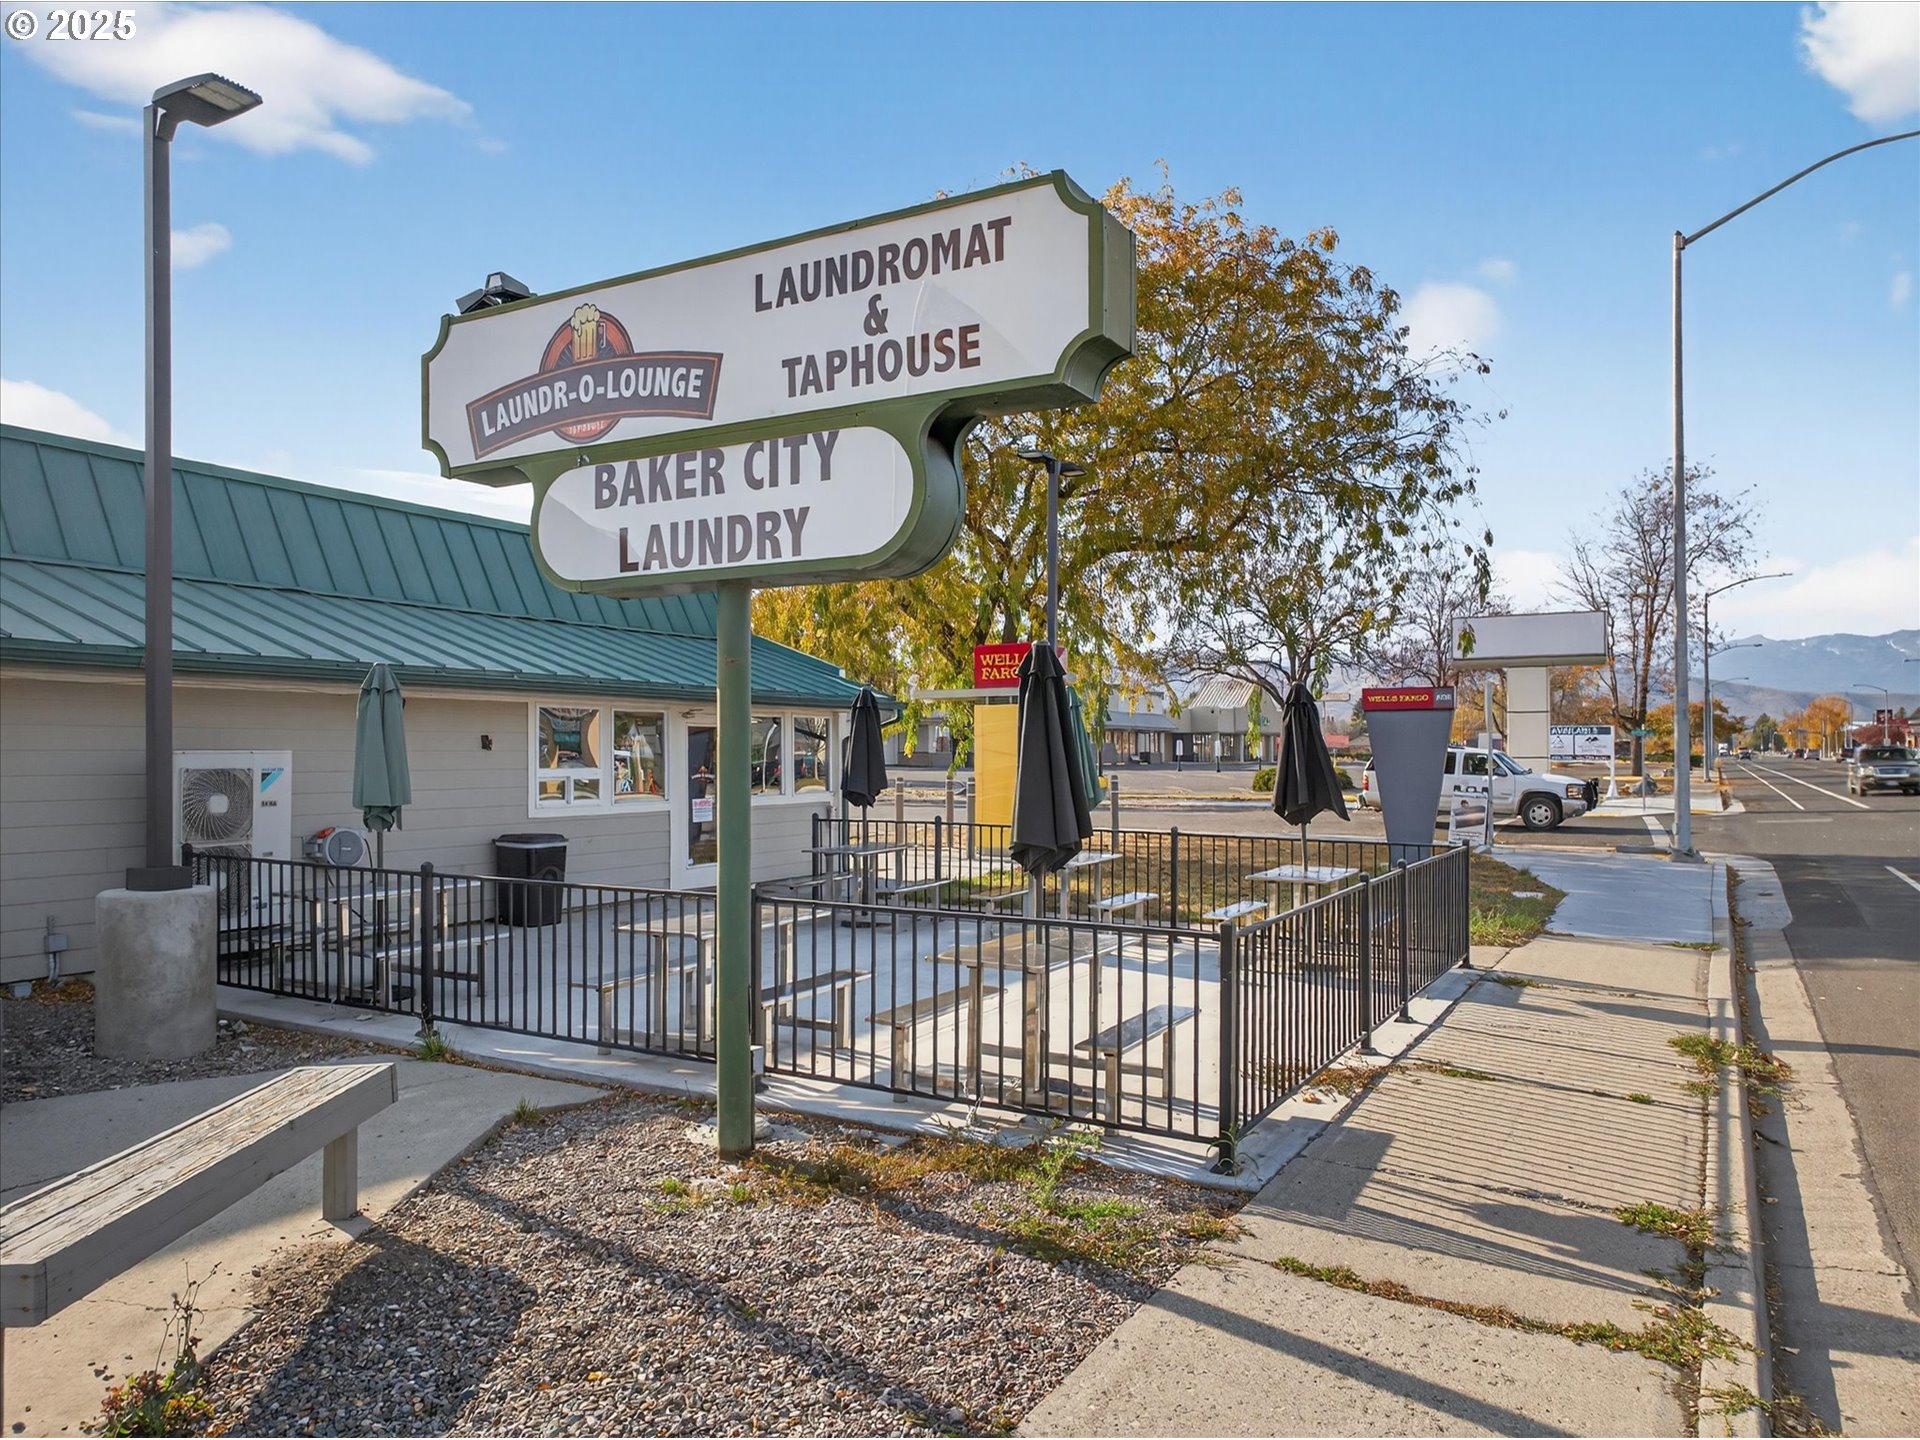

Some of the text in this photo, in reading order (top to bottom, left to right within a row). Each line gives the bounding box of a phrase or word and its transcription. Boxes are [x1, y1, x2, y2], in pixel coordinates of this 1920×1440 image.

[754, 216, 1012, 313] LAUNDROMAT
[863, 293, 889, 336] &
[781, 323, 981, 398] TAPHOUSE
[481, 367, 704, 437] LAUNDR-O-LOUNGE
[594, 430, 840, 510] BAKER CITY
[619, 506, 811, 573] LAUNDRY
[979, 653, 1020, 666] WELL
[981, 666, 1018, 680] FARG
[1367, 694, 1398, 703] WELLS
[1399, 694, 1429, 702] FARGO
